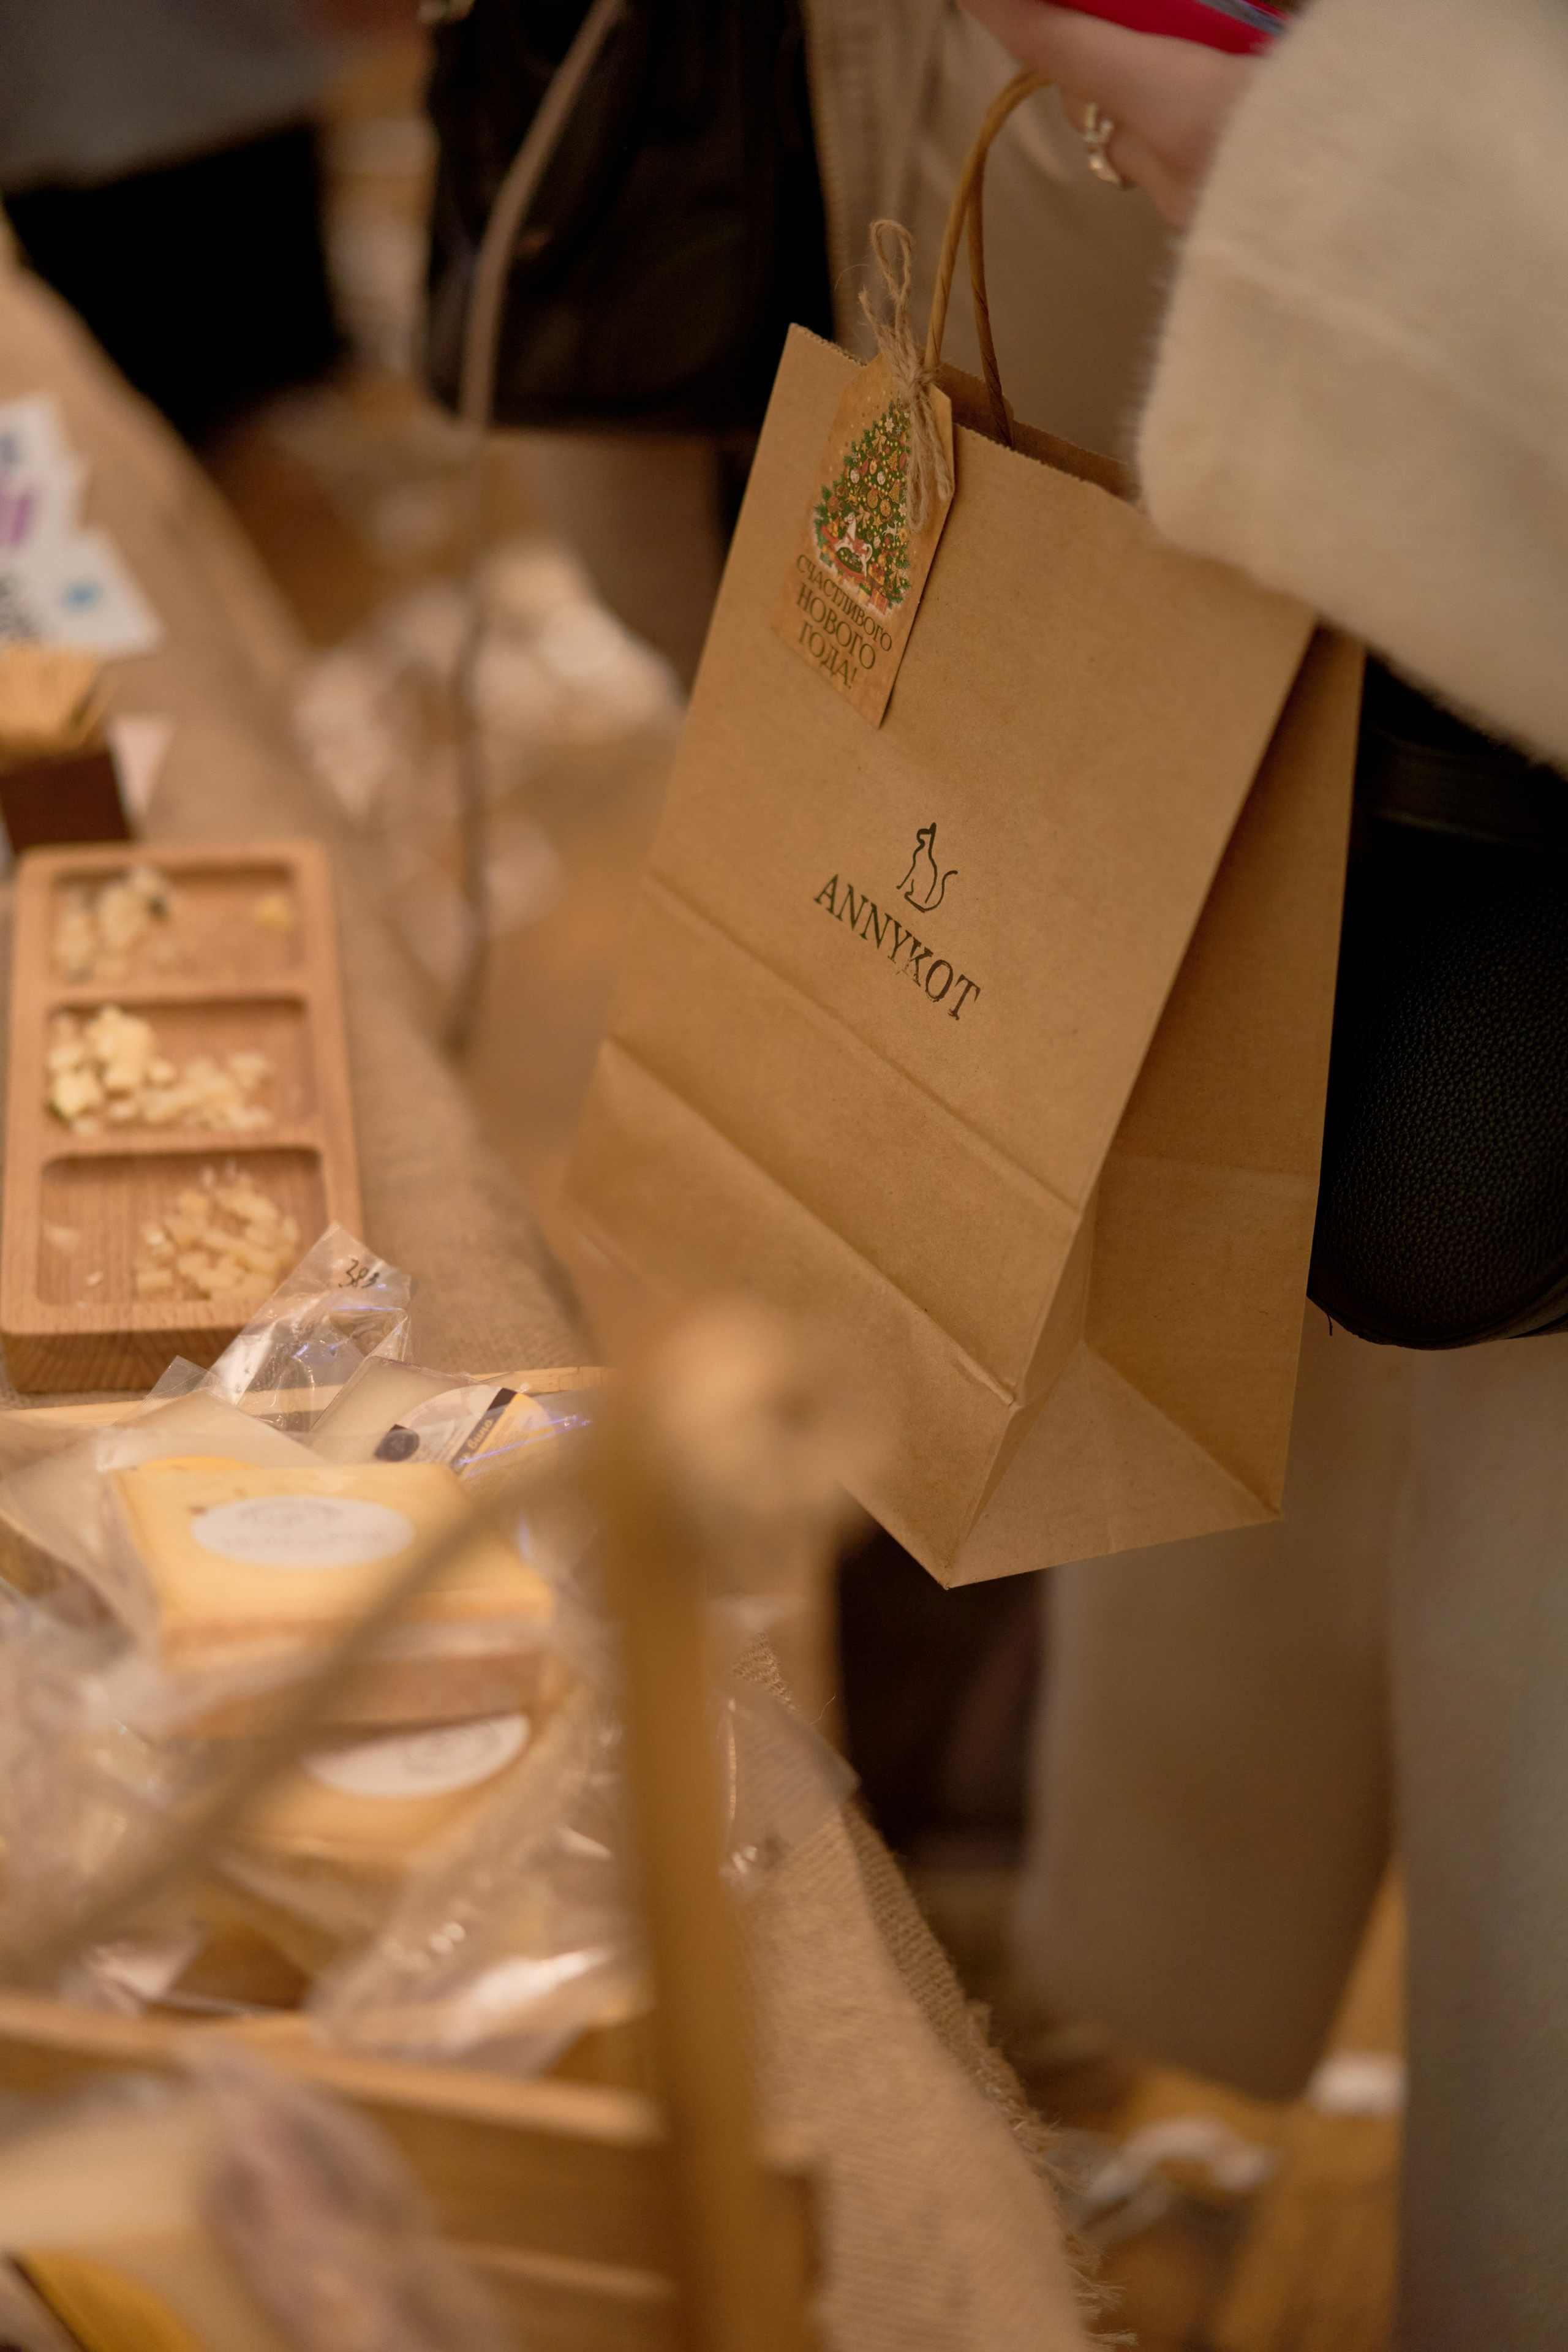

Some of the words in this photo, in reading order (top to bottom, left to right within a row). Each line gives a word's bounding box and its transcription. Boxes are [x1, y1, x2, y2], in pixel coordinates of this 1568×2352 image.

[797, 554, 892, 651] СЧАСТЛИВОГО
[797, 582, 875, 669] НОВОГО
[798, 620, 857, 689] ГОДА!
[813, 873, 981, 1020] ANNYKOT
